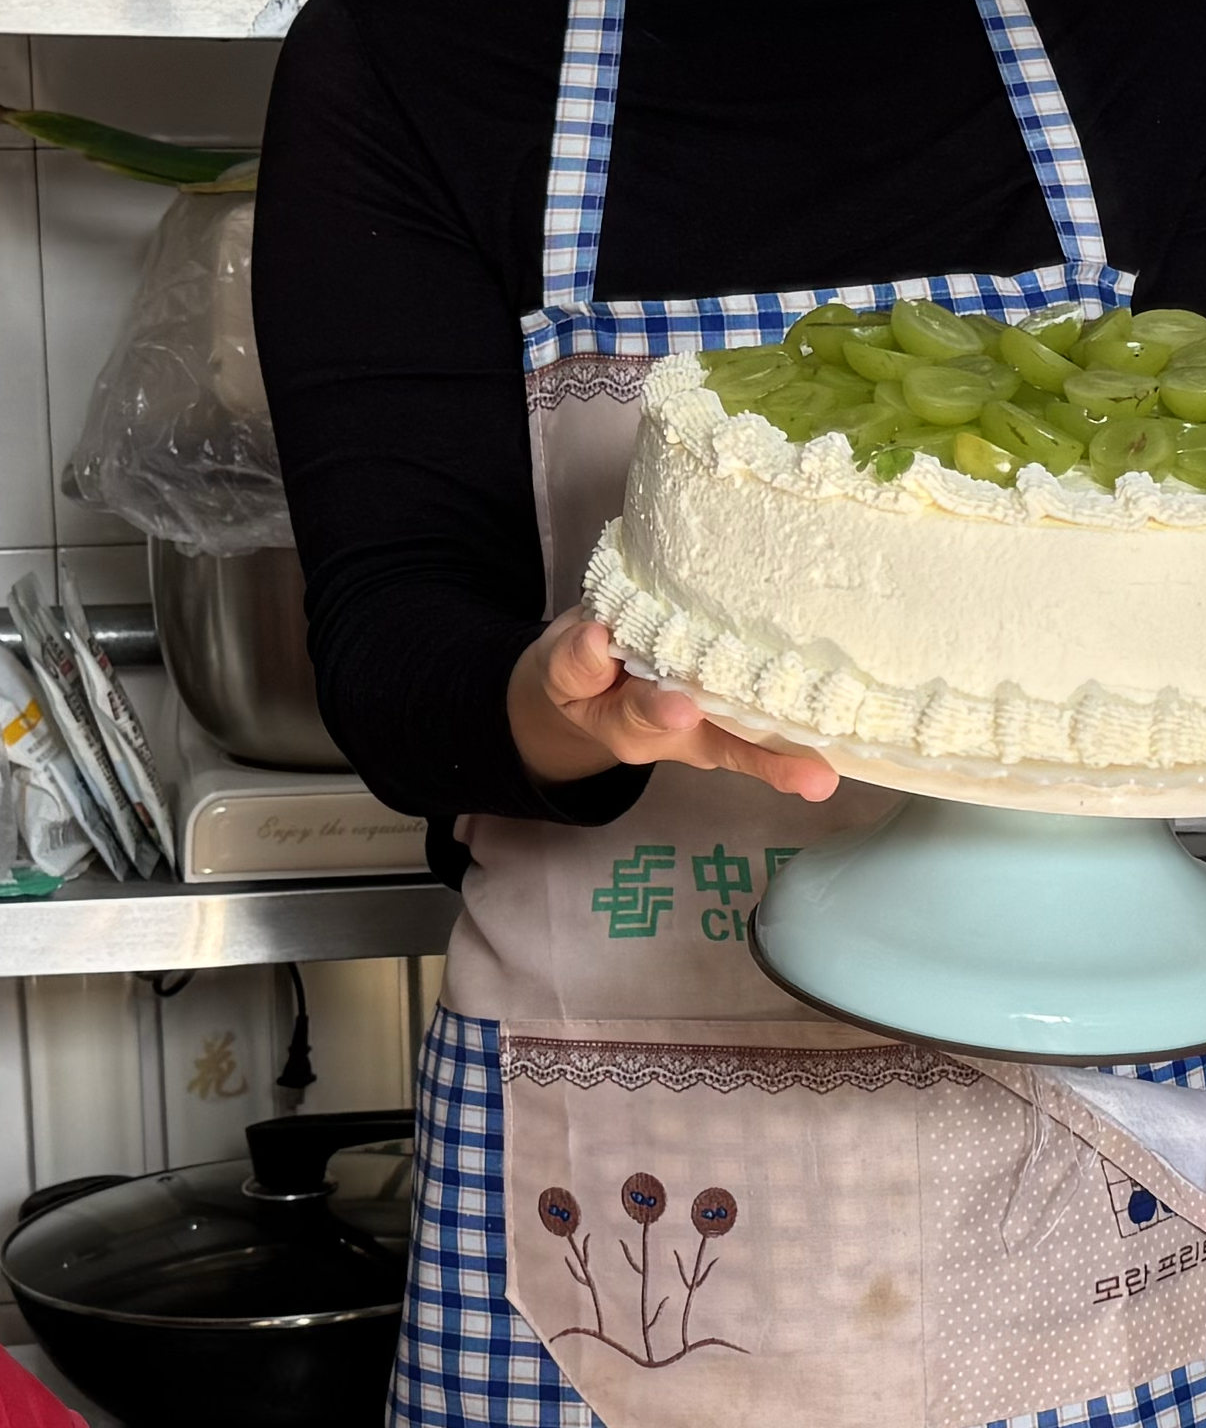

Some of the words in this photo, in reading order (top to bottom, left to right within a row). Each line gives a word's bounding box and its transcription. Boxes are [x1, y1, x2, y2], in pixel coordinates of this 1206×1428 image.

[257, 816, 313, 844] Enjoy
[319, 818, 346, 836] the
[186, 1029, 250, 1101] 花
[1092, 1262, 1151, 1305] 모란
